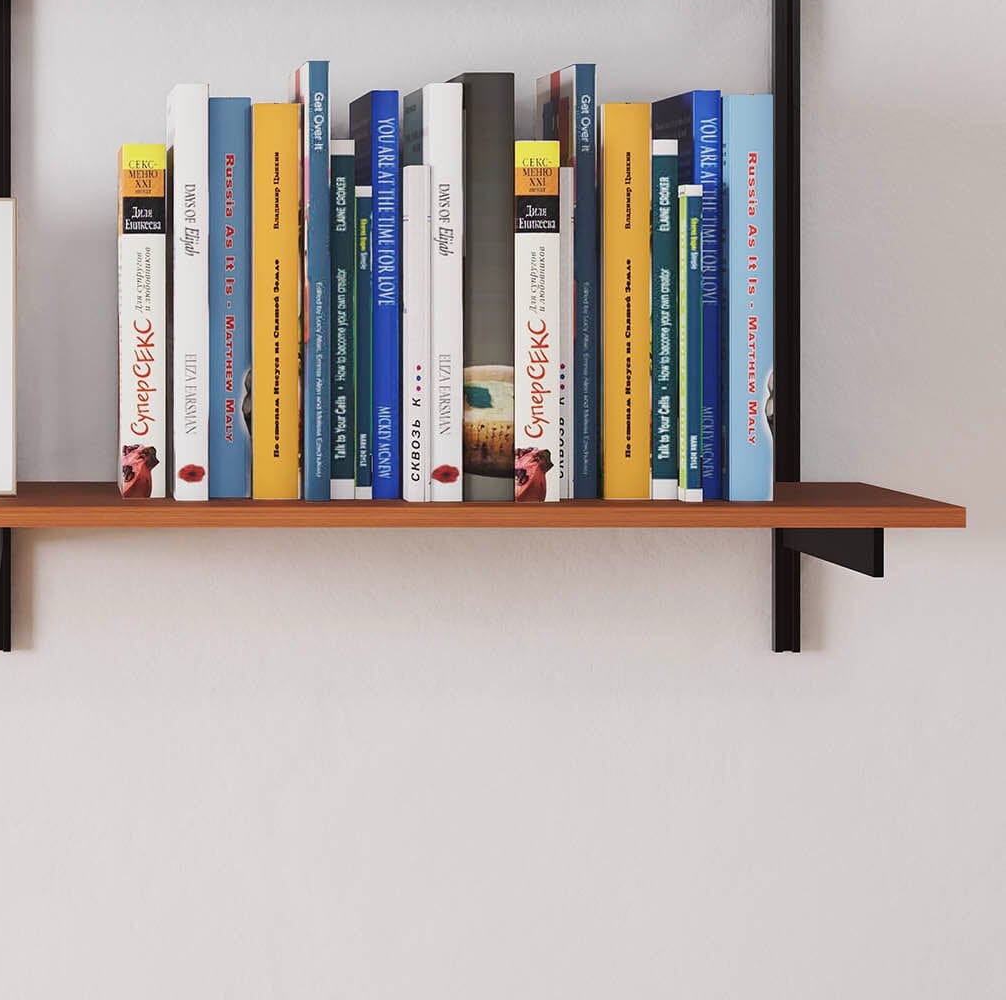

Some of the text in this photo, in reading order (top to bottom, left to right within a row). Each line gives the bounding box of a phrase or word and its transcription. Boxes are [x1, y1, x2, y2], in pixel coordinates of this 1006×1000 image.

[314, 92, 324, 151] Get Over It
[581, 94, 592, 114] Get
[581, 117, 592, 142] Over
[225, 152, 235, 217] Russia
[378, 117, 395, 305] YOU ARE AT THE TIME FOR LOVE
[700, 117, 717, 305] YOU ARE AT THE TIME FOR LOVE
[748, 152, 758, 217] Russia
[179, 183, 200, 257] DAYS OF Elijah
[225, 225, 235, 248] As
[434, 183, 454, 257] DAYS OF Elijah
[748, 225, 758, 248] As
[225, 256, 235, 271] It
[225, 278, 235, 296] Is
[748, 256, 758, 271] It
[748, 278, 758, 296] Is
[131, 319, 156, 436] СуперСЕКС
[185, 353, 196, 434] ELIZA EARSMAN
[439, 353, 450, 434] ELIZA EARSMAN
[525, 320, 552, 438] СуперСЕКС
[378, 406, 392, 441] MICKEY
[410, 419, 420, 482] СКВОЗЬ
[702, 406, 714, 441] MICKEY
